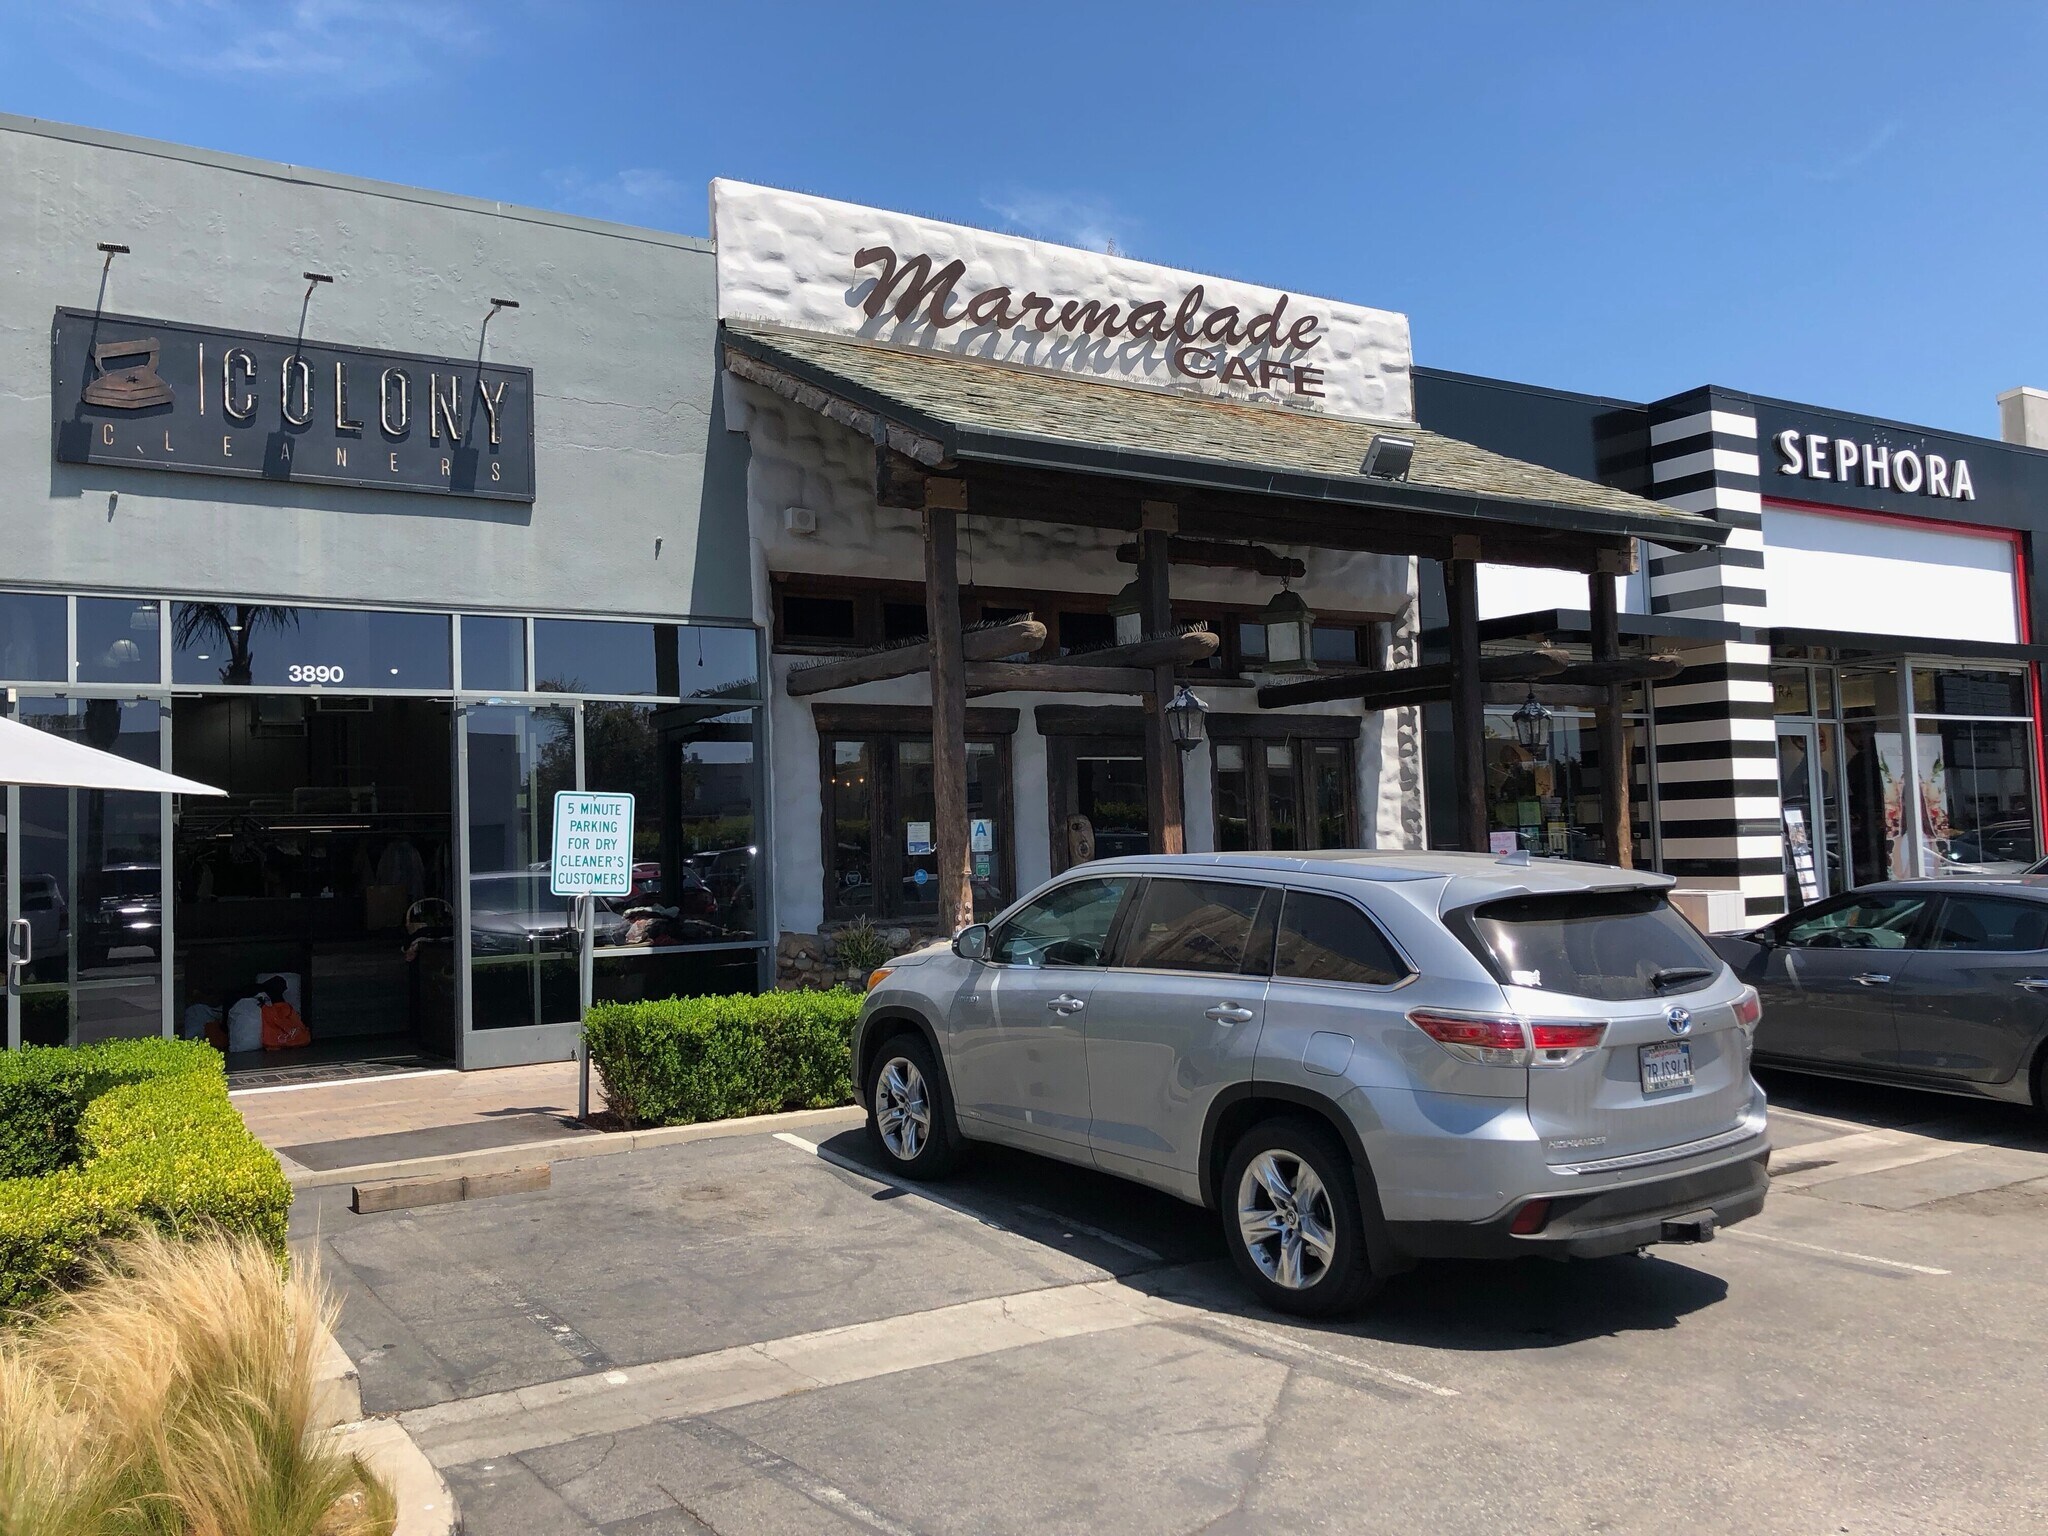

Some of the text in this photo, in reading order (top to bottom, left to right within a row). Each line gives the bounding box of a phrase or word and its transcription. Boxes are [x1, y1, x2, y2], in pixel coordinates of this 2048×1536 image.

[854, 246, 1322, 348] Marmalade
[1174, 347, 1325, 398] CAFE
[223, 347, 511, 445] COLONY
[103, 423, 501, 481] CLEANERS
[1778, 429, 1976, 501] SEPHORA
[288, 664, 345, 683] 3890
[567, 802, 622, 816] 5 MINUTE
[570, 820, 618, 833] PARKING
[975, 822, 987, 836] A
[568, 837, 618, 851] FOR DRY
[560, 855, 624, 868] CLEANER'S
[558, 872, 625, 885] CUSTOMERS
